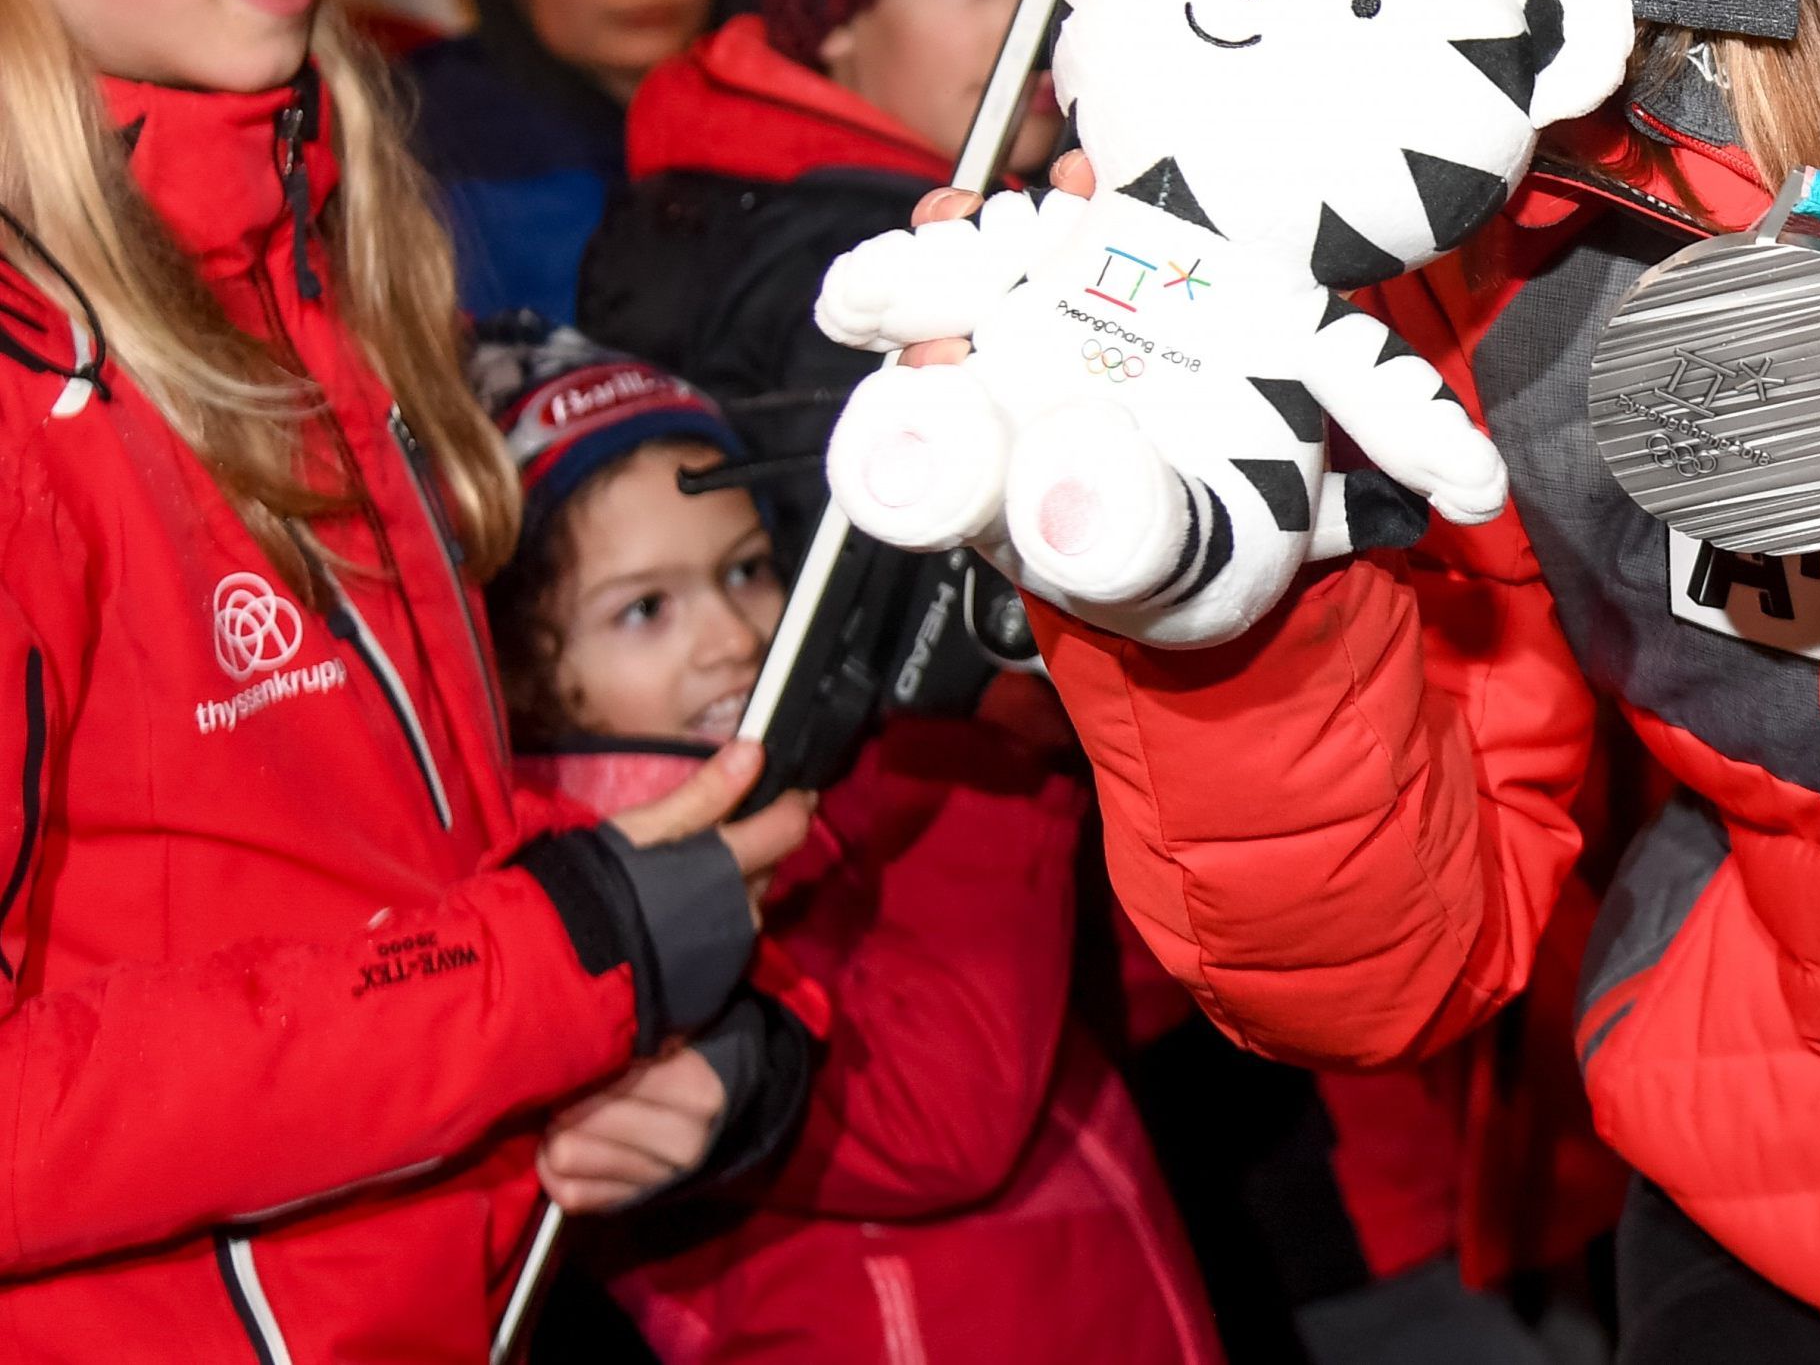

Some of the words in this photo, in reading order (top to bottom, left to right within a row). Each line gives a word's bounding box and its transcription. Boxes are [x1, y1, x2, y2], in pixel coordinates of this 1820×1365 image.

[1056, 300, 1155, 354] PyeongChang
[1161, 345, 1202, 373] 2018
[1615, 393, 1731, 451] PyeongChang
[1733, 438, 1772, 467] 2018
[893, 580, 957, 703] HEAD
